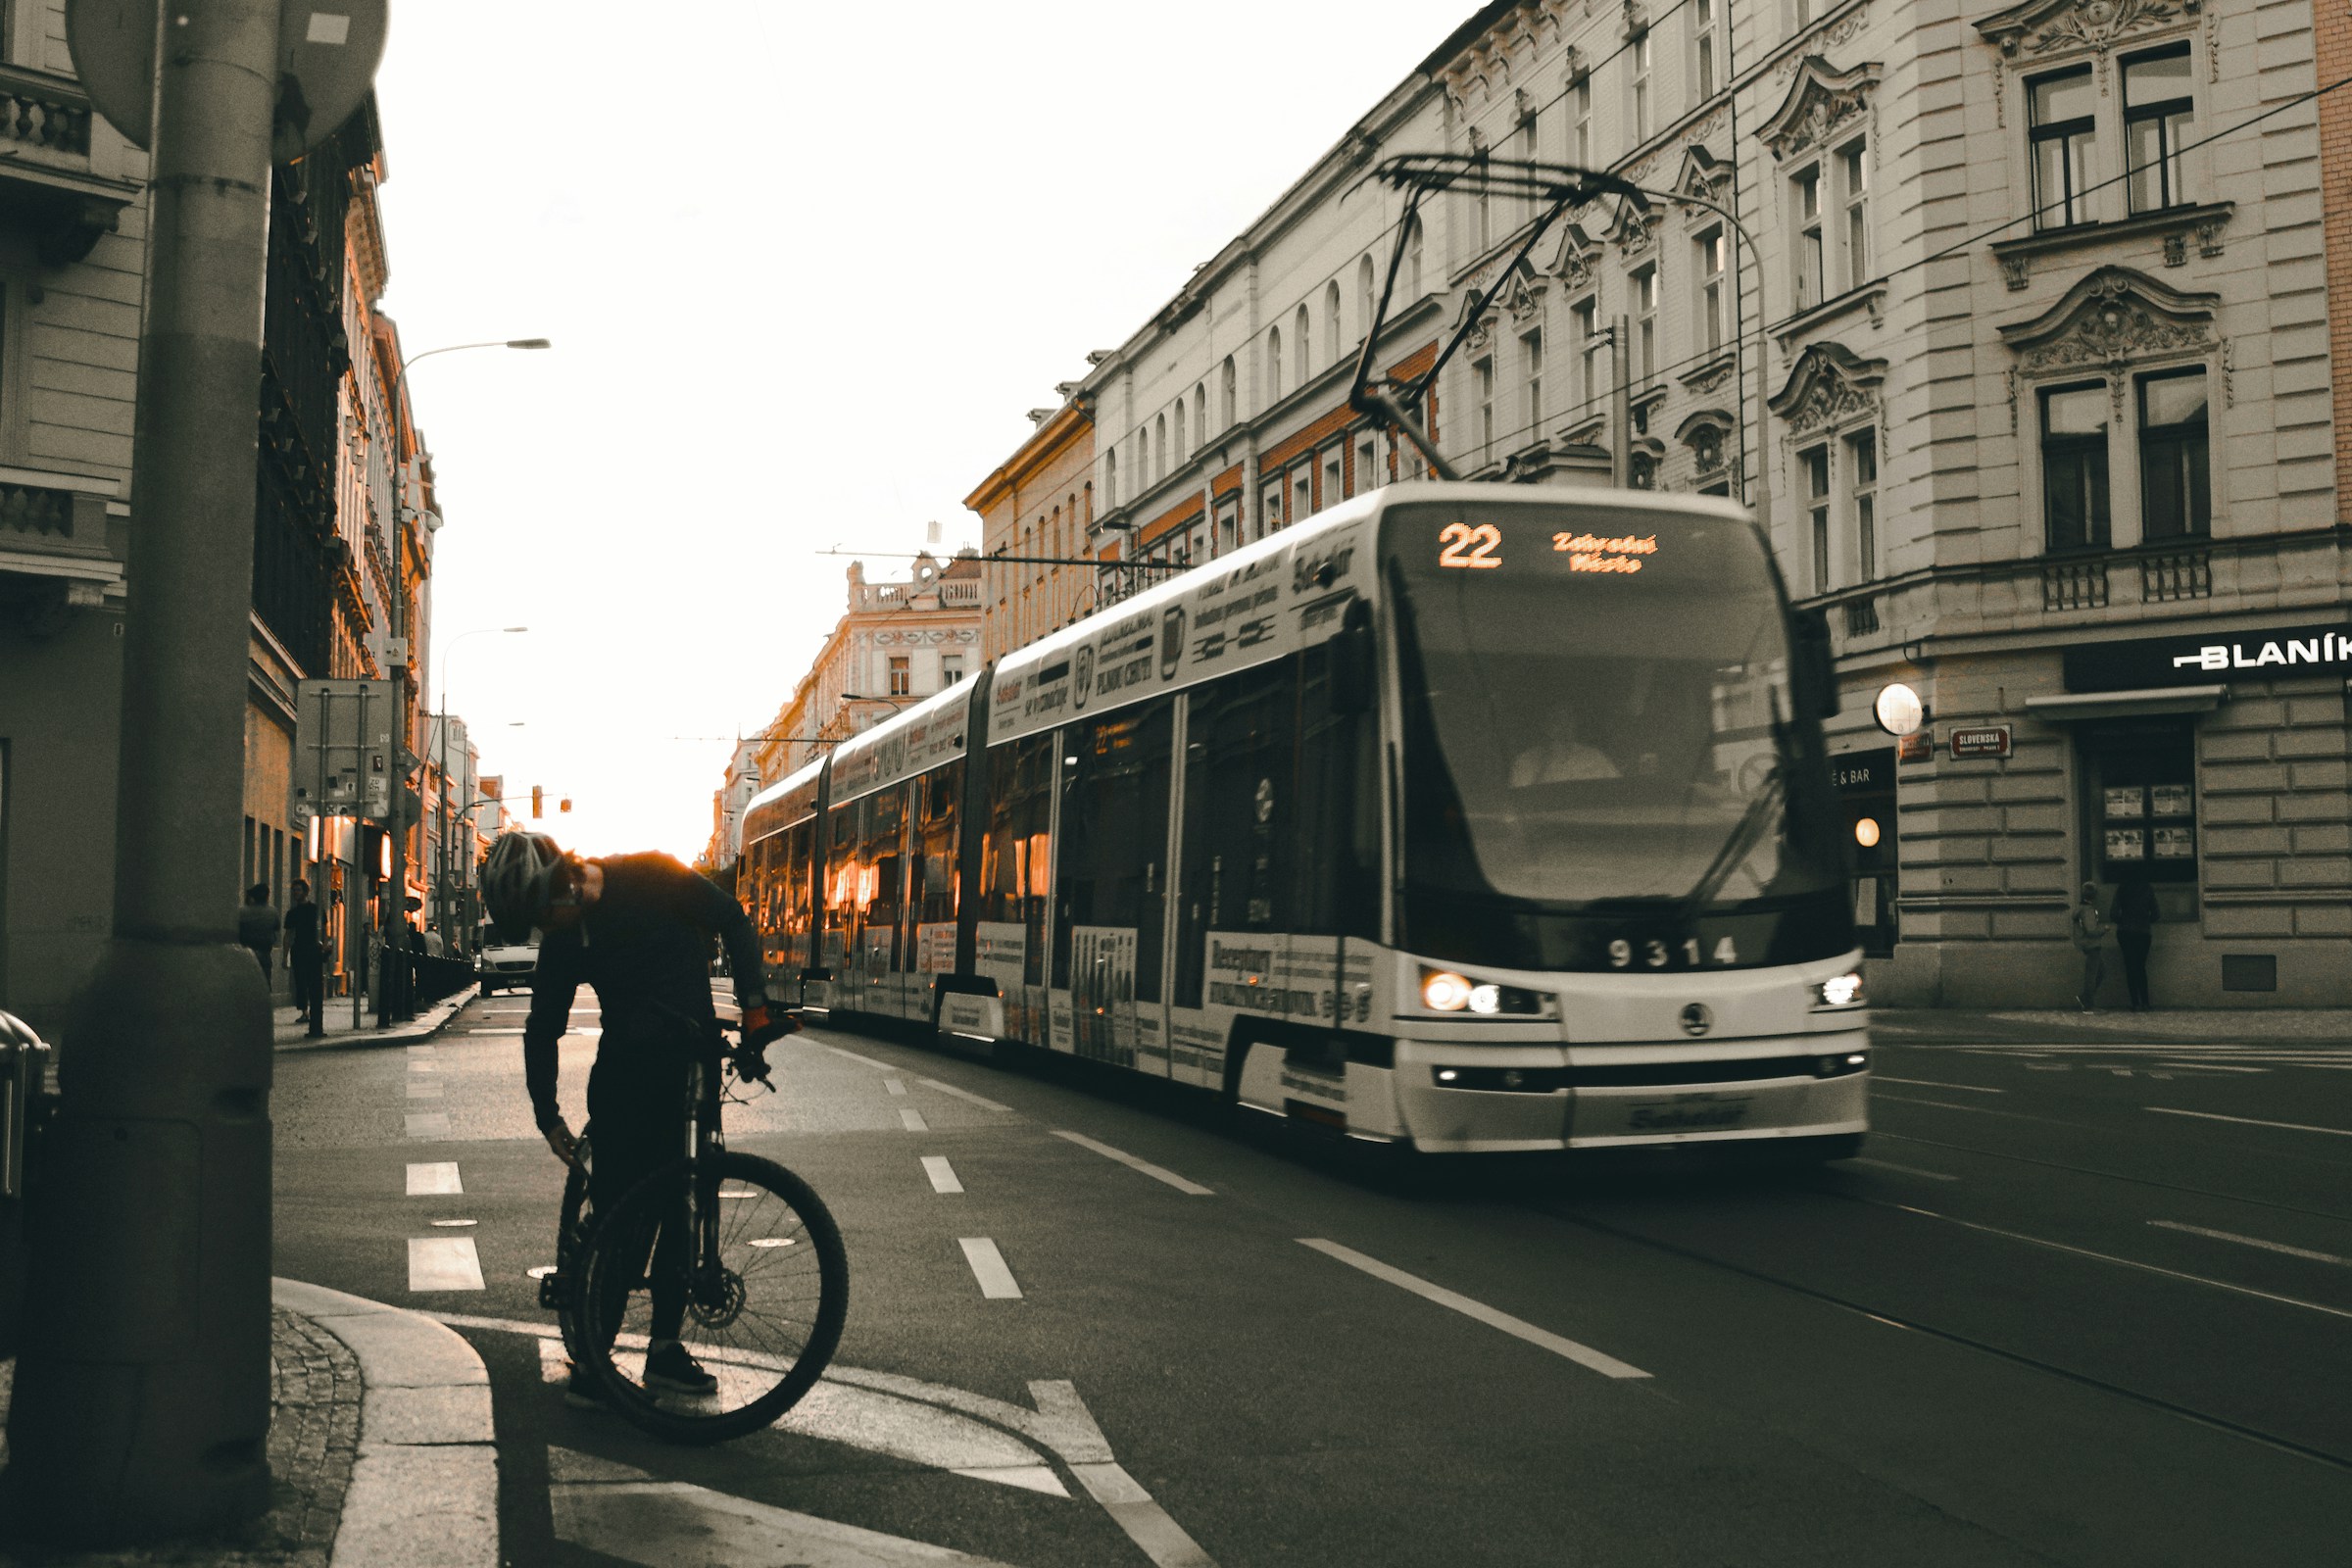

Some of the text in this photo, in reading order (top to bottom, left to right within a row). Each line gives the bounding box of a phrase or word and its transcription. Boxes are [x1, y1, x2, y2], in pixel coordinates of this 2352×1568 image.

[1439, 521, 1503, 568] 22
[1959, 732, 2000, 745] SLOVENSKÁ
[1839, 770, 1847, 785] &
[1850, 768, 1870, 784] BAR
[1608, 936, 1738, 967] 9314
